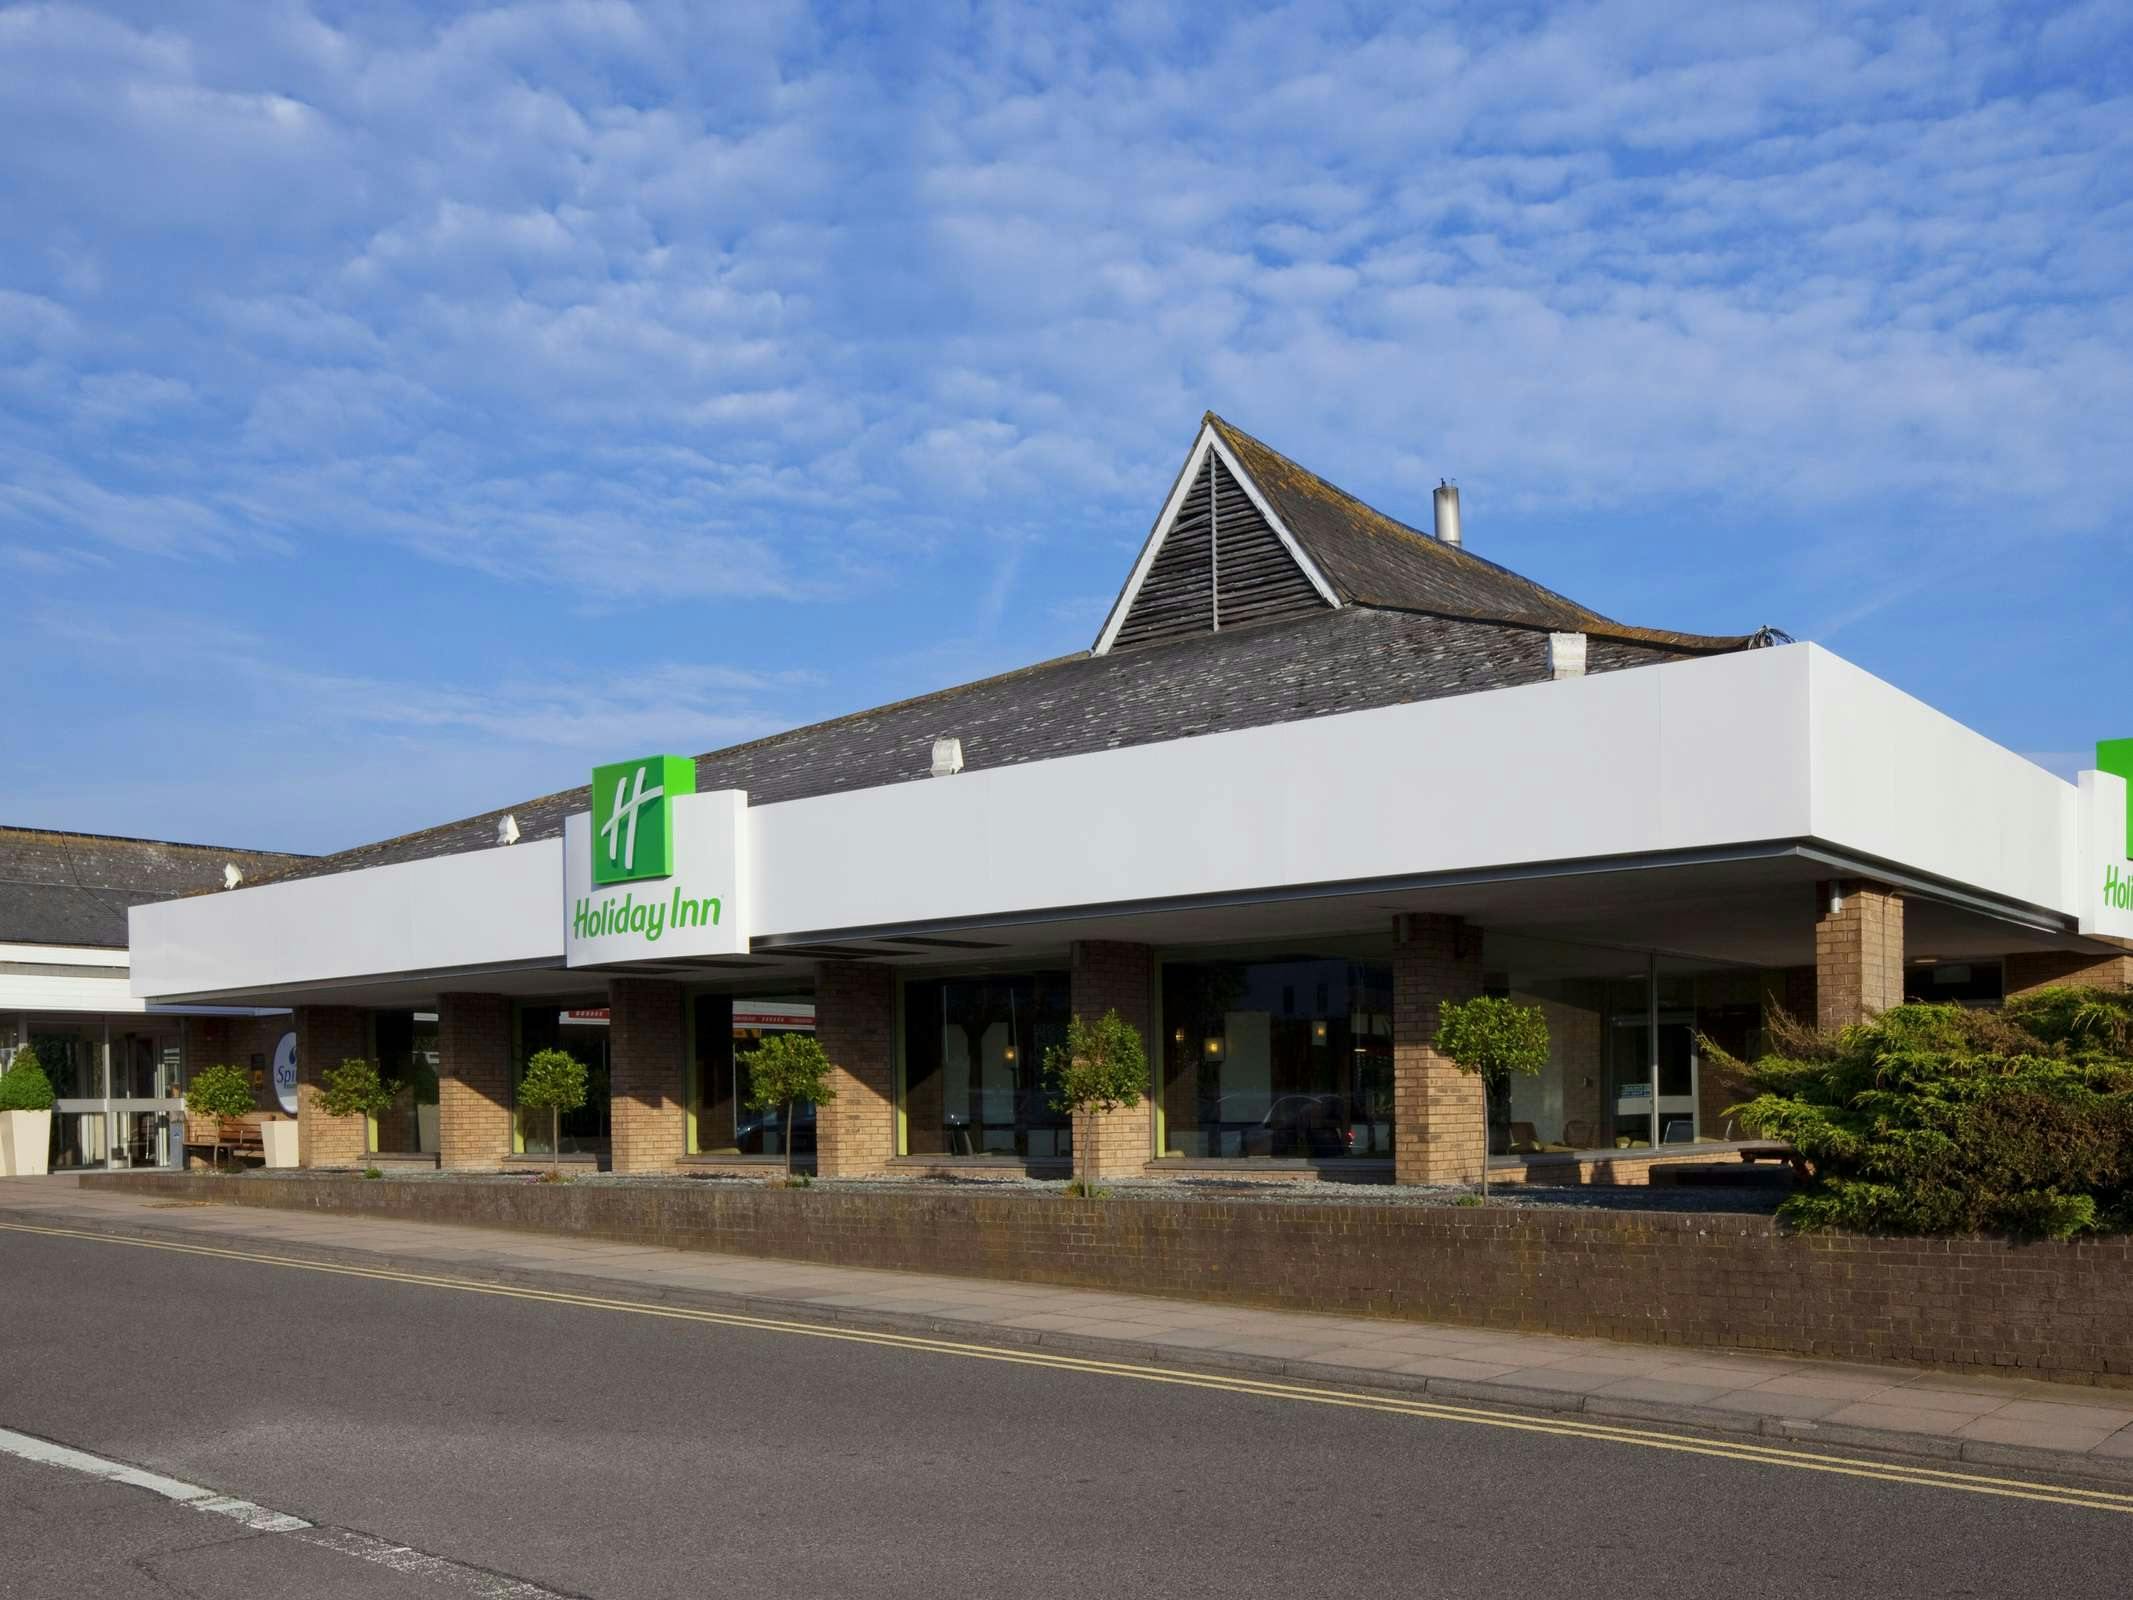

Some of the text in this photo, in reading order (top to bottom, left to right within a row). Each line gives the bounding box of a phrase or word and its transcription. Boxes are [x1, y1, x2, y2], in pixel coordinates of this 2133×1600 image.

[601, 766, 664, 870] H
[573, 886, 721, 942] Holiday Inn
